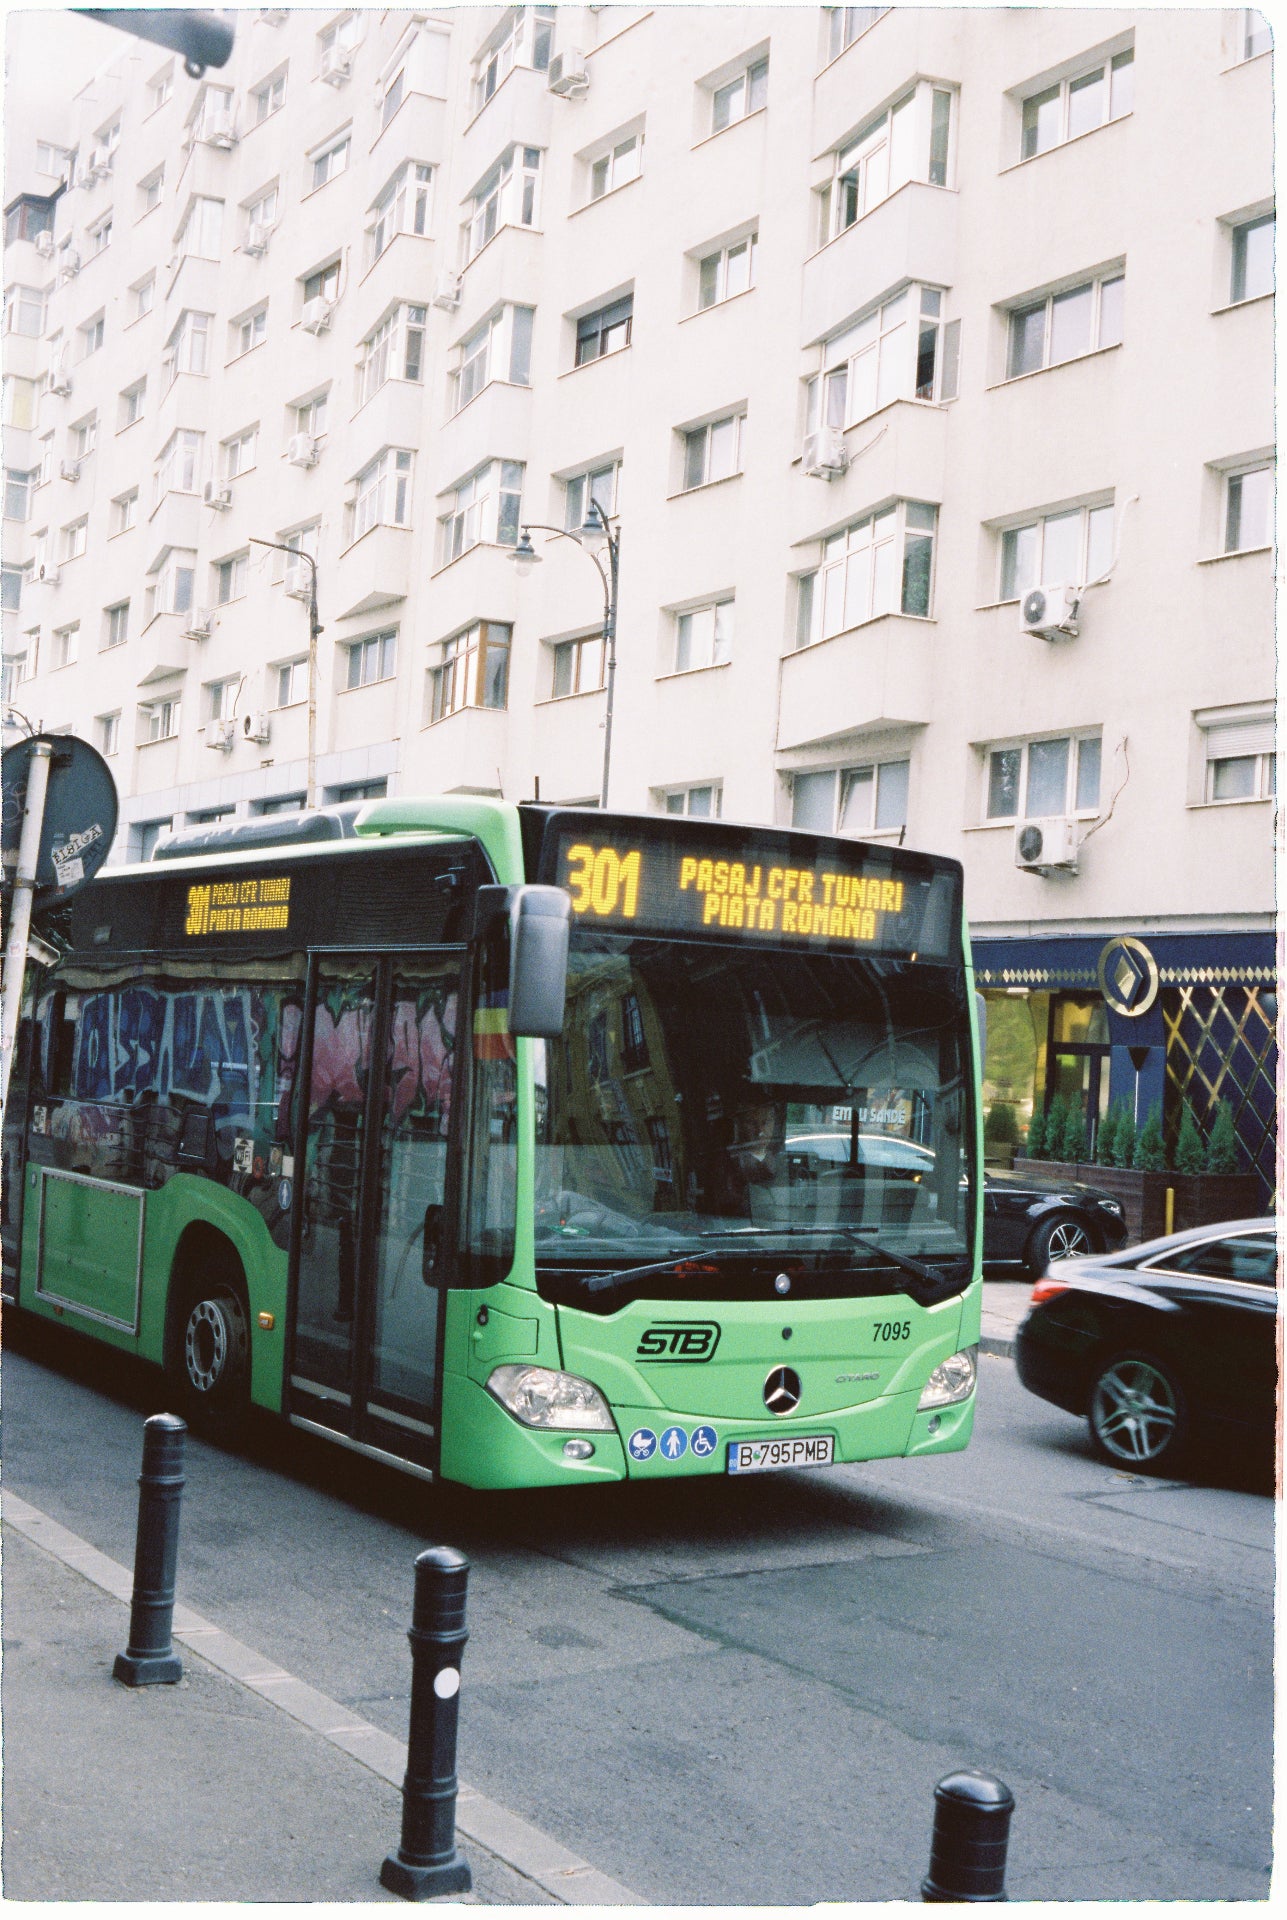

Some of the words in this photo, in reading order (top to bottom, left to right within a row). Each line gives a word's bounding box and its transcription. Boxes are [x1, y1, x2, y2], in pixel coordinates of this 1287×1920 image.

[567, 844, 641, 918] 301
[680, 857, 761, 893] PASAJ
[768, 868, 814, 902] CFR
[822, 874, 903, 913] TUNARI
[703, 894, 776, 931] PIATA
[782, 901, 876, 940] ROMANA
[636, 1329, 713, 1355] STB
[873, 1321, 911, 1342] 7095
